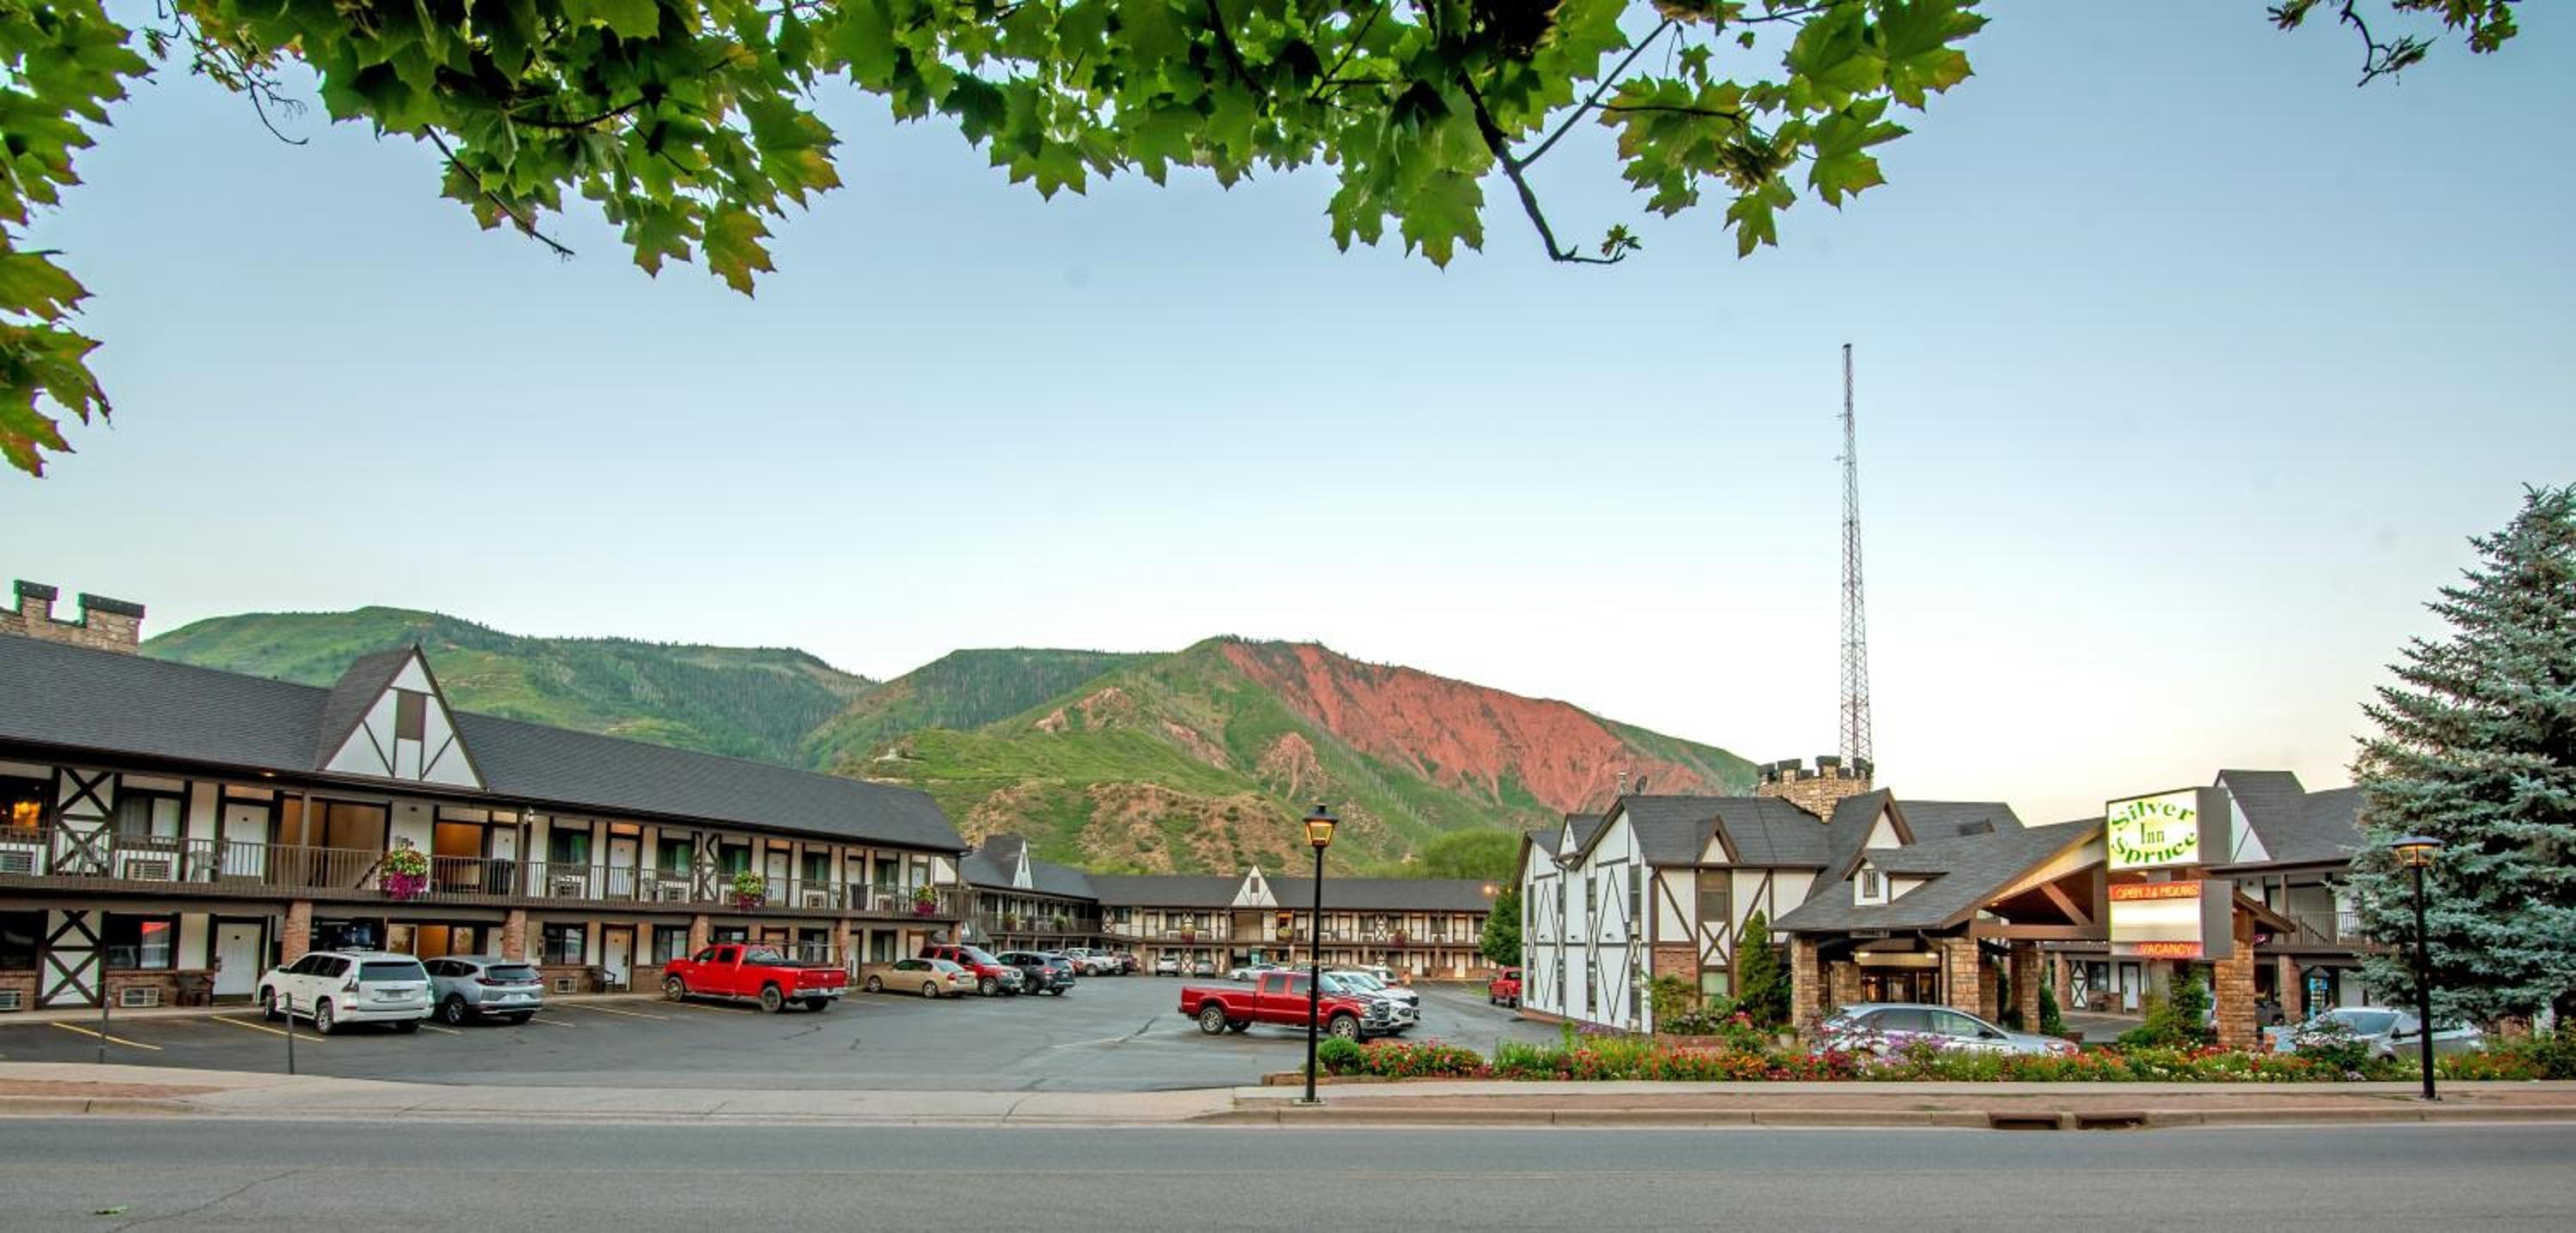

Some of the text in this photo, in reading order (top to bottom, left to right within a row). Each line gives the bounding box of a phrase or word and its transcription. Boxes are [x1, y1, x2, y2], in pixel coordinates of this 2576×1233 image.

[2111, 801, 2195, 831] Silver
[2140, 823, 2165, 844] Inn
[2111, 833, 2196, 864] Spruce
[2116, 884, 2199, 898] OPEN 24 HOURS
[2142, 944, 2192, 956] VACANCY
